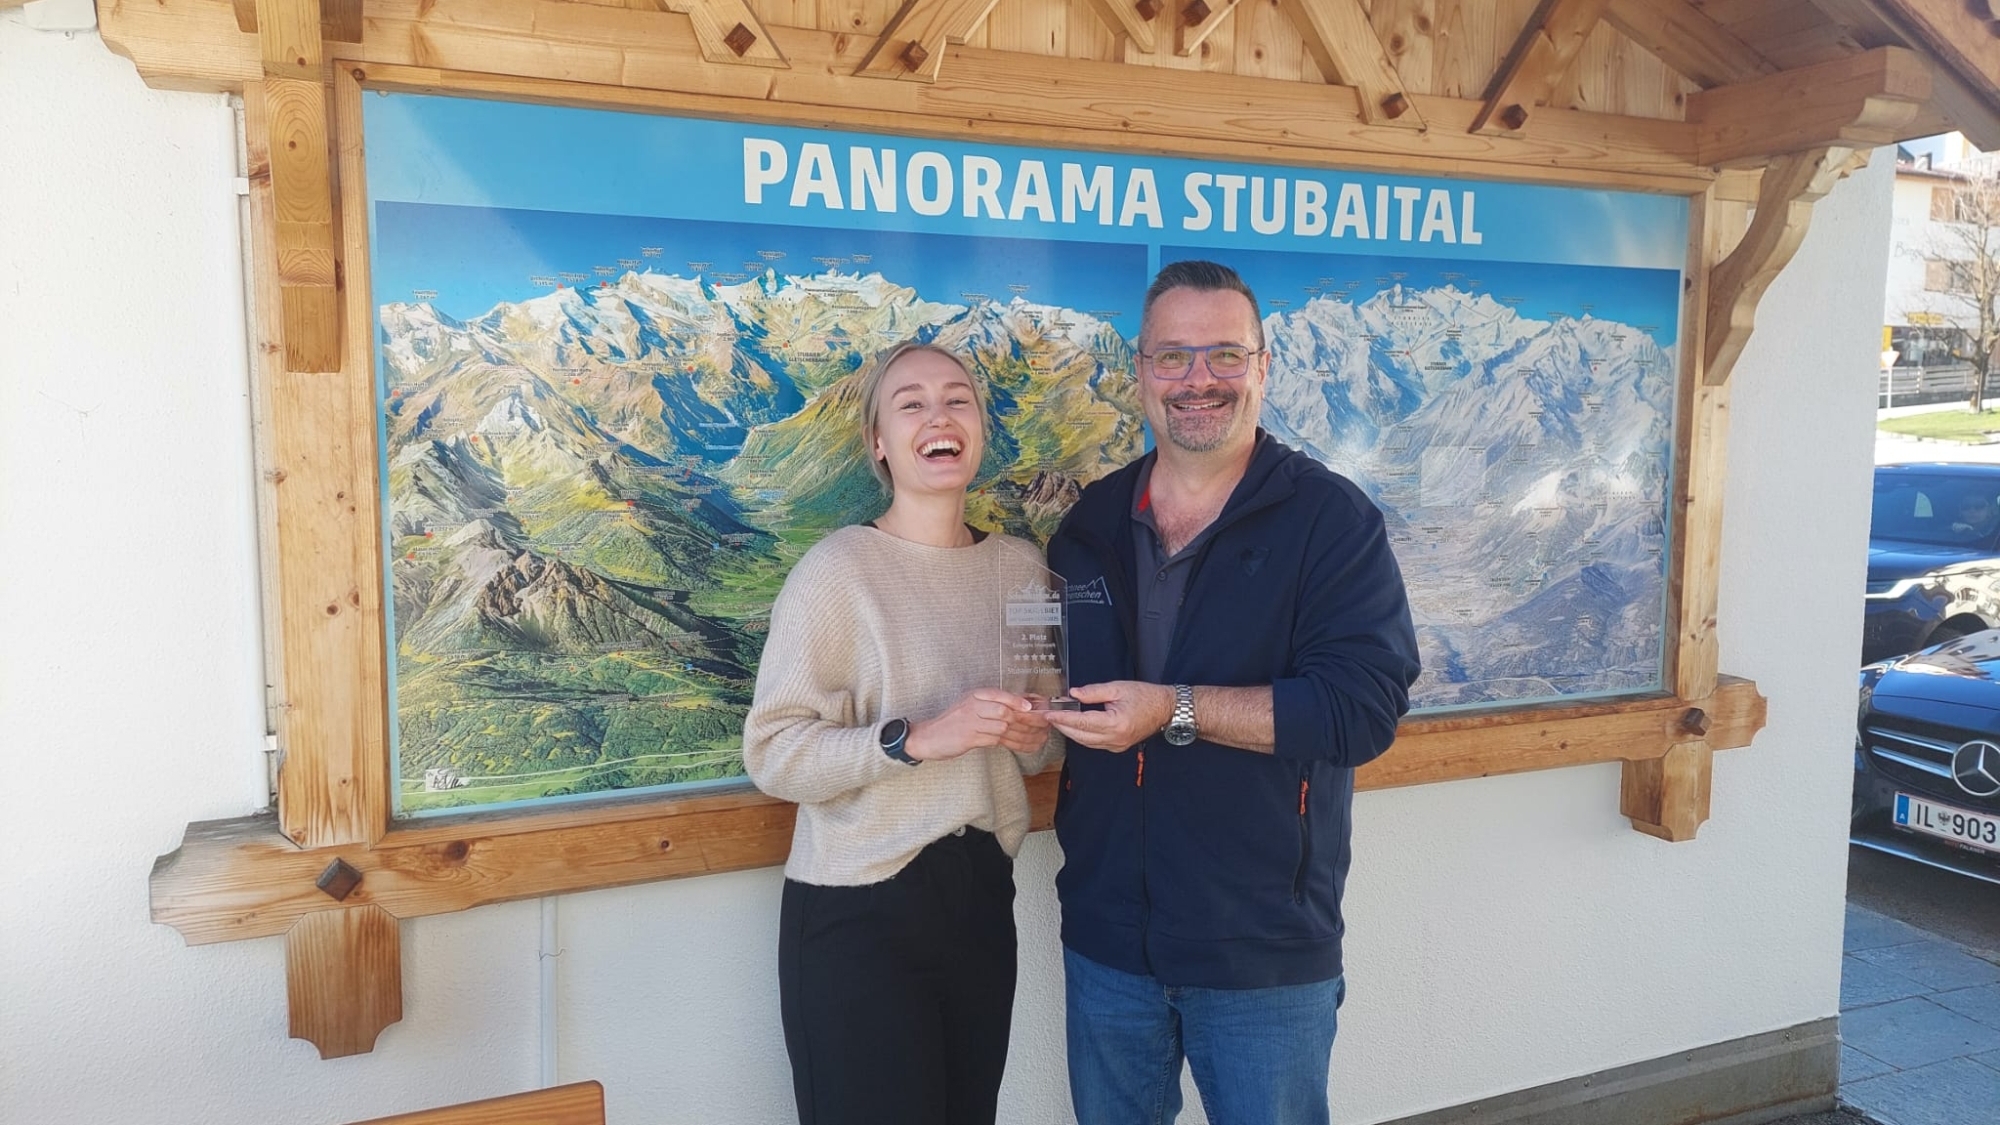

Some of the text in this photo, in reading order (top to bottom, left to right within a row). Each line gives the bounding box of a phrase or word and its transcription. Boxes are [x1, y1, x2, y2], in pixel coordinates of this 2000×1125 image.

[743, 136, 1483, 245] PANORAMA STUBAITAL
[1916, 803, 1934, 828] IL
[1952, 813, 1997, 844] 903
